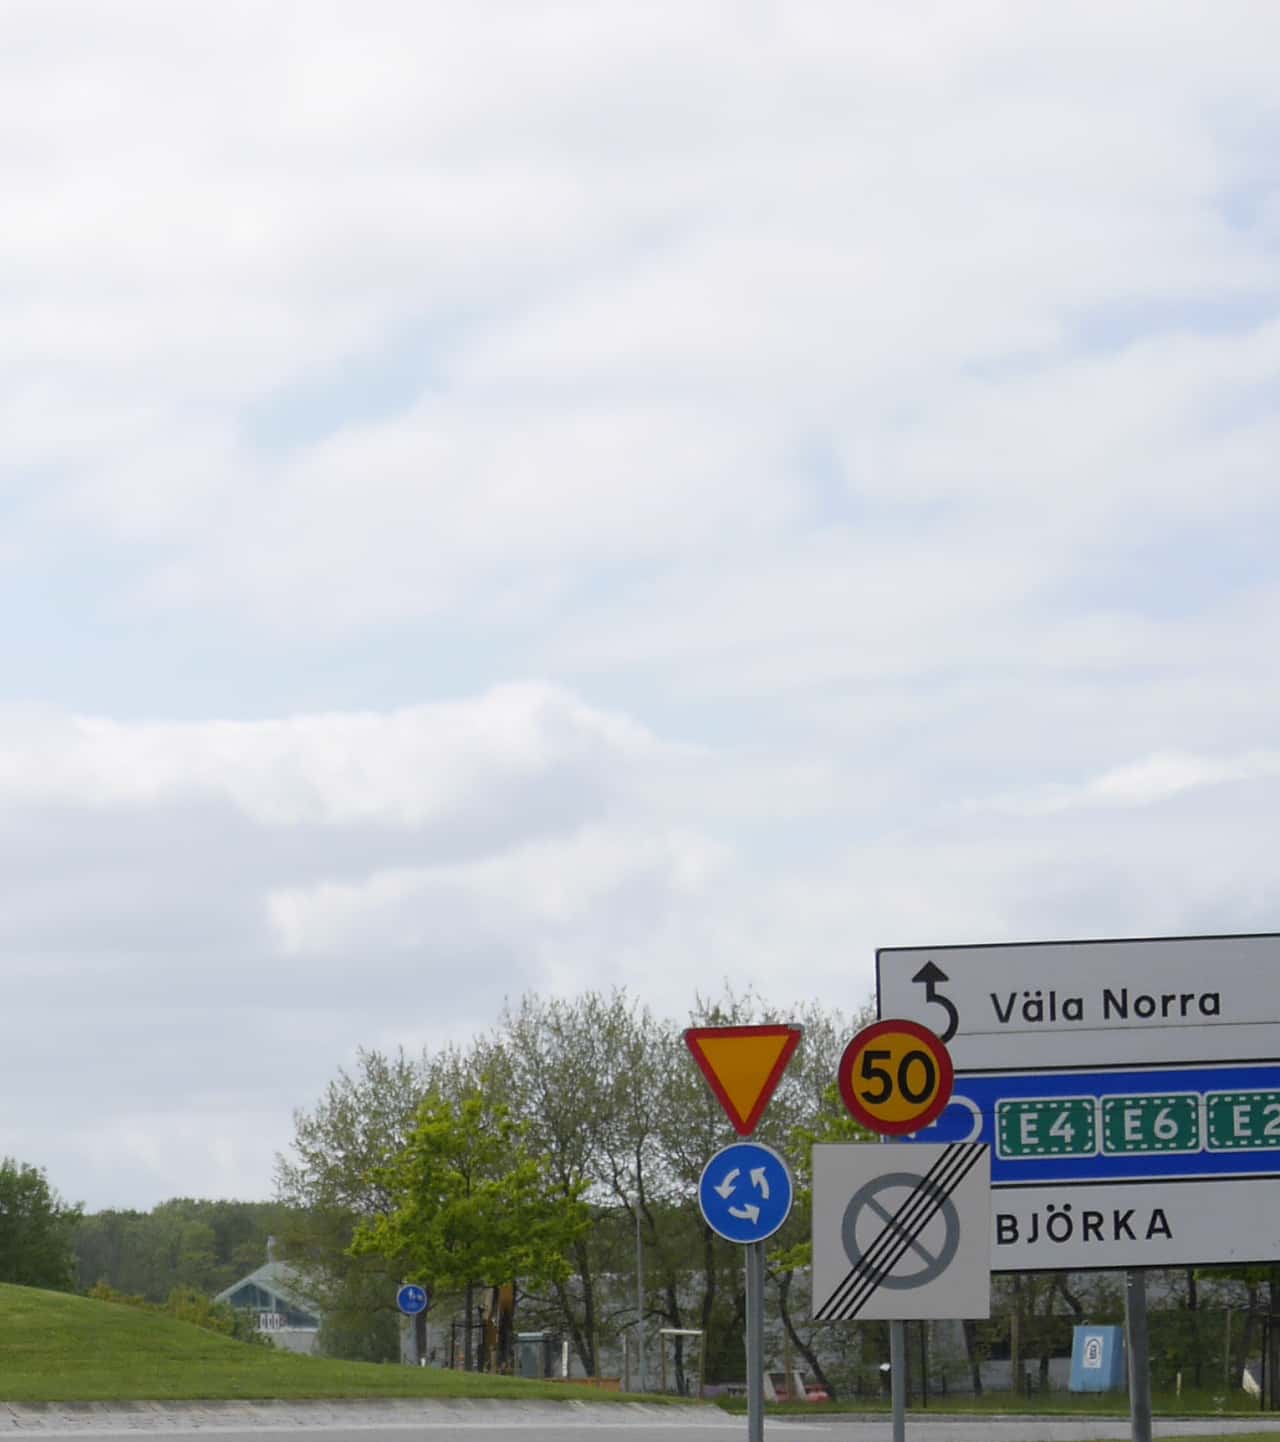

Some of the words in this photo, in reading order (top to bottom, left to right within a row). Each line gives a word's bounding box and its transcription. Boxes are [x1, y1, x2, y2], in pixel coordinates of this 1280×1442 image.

[990, 990, 1084, 1023] Väla
[1103, 988, 1221, 1020] Norra
[861, 1050, 935, 1104] 50
[996, 1203, 1173, 1245] BJÖRKA
